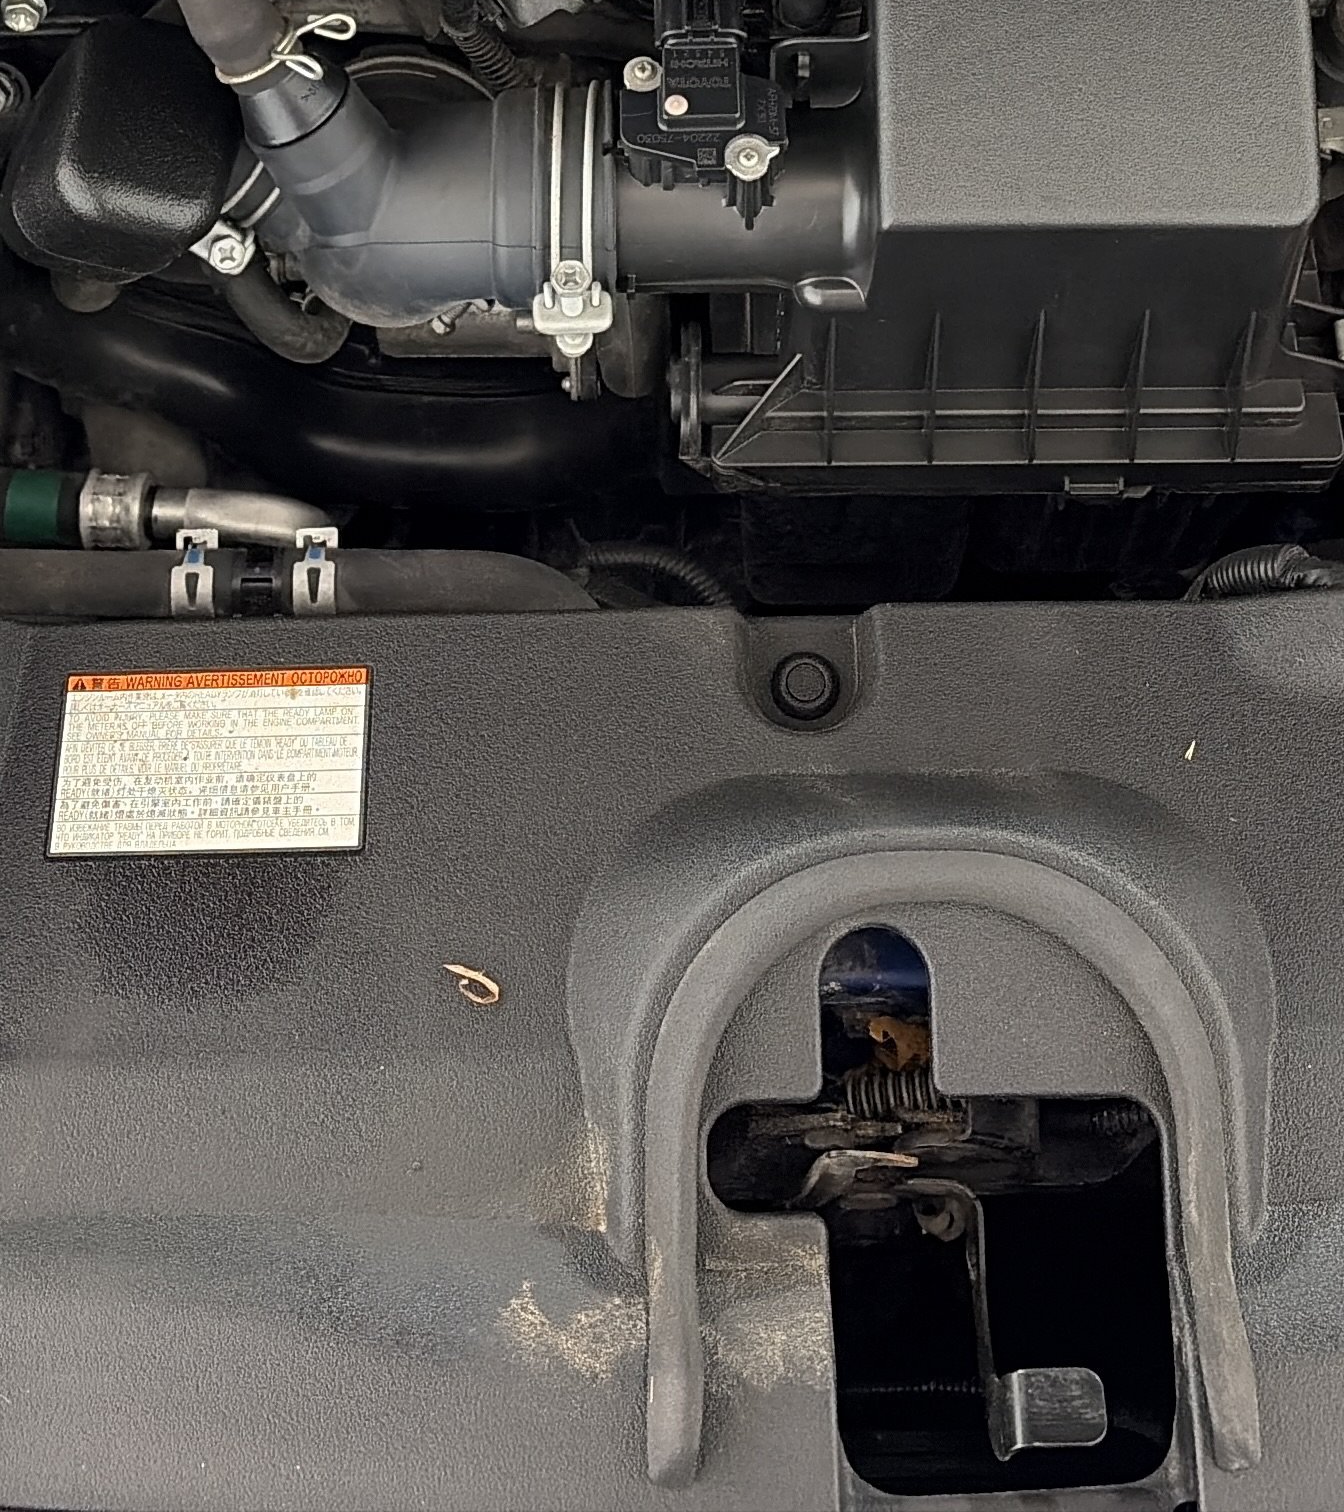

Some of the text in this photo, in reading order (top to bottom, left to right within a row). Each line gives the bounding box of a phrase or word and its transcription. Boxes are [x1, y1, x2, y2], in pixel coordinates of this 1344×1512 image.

[667, 76, 731, 88] TOYOTA
[636, 133, 720, 143] 22204-75030
[124, 671, 287, 689] WARNING AVERTISSEMENT
[84, 713, 110, 722] AVOID
[148, 711, 180, 720] PLEASE
[183, 710, 207, 719] MAKE
[210, 710, 232, 719] SURE
[237, 709, 258, 718] THAT
[263, 709, 279, 718] THE
[282, 708, 310, 717] READY
[314, 707, 337, 716] LAMP
[340, 706, 354, 716] ON
[67, 723, 82, 732] THE
[150, 720, 184, 729] BEFORE
[242, 718, 259, 727] THE
[262, 717, 293, 727] ENGINE
[126, 729, 161, 738] MANUAL
[165, 729, 183, 737] FOR
